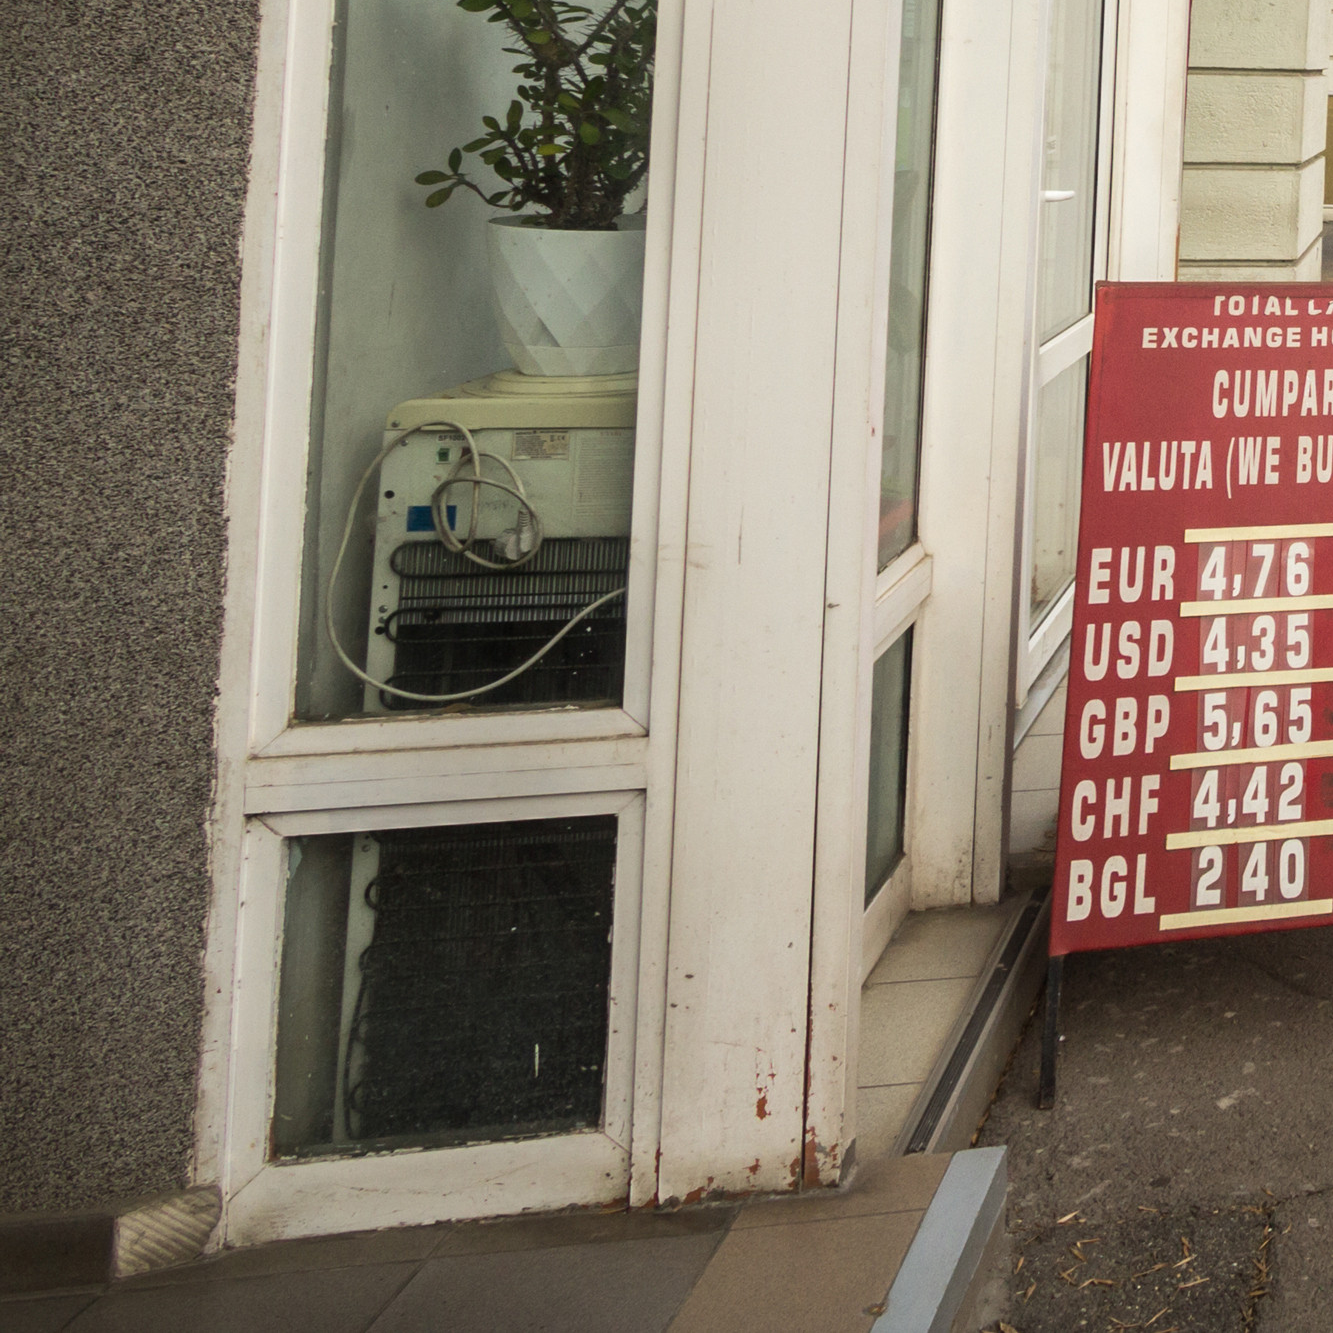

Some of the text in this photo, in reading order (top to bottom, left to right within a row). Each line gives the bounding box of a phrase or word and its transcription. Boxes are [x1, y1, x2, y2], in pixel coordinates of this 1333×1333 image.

[1142, 327, 1301, 349] EXCHANGE
[1102, 440, 1214, 492] VALUTA
[1226, 435, 1281, 499] (WE
[1087, 546, 1176, 606] EUR
[1200, 541, 1310, 601] 4,76
[1083, 619, 1174, 681] USD
[1203, 614, 1310, 672] 4,35
[1079, 696, 1170, 759] GBP
[1204, 687, 1313, 751] 5,65
[1071, 775, 1160, 842] CHF
[1193, 762, 1304, 828] 4,42
[1066, 853, 1155, 922] BGL
